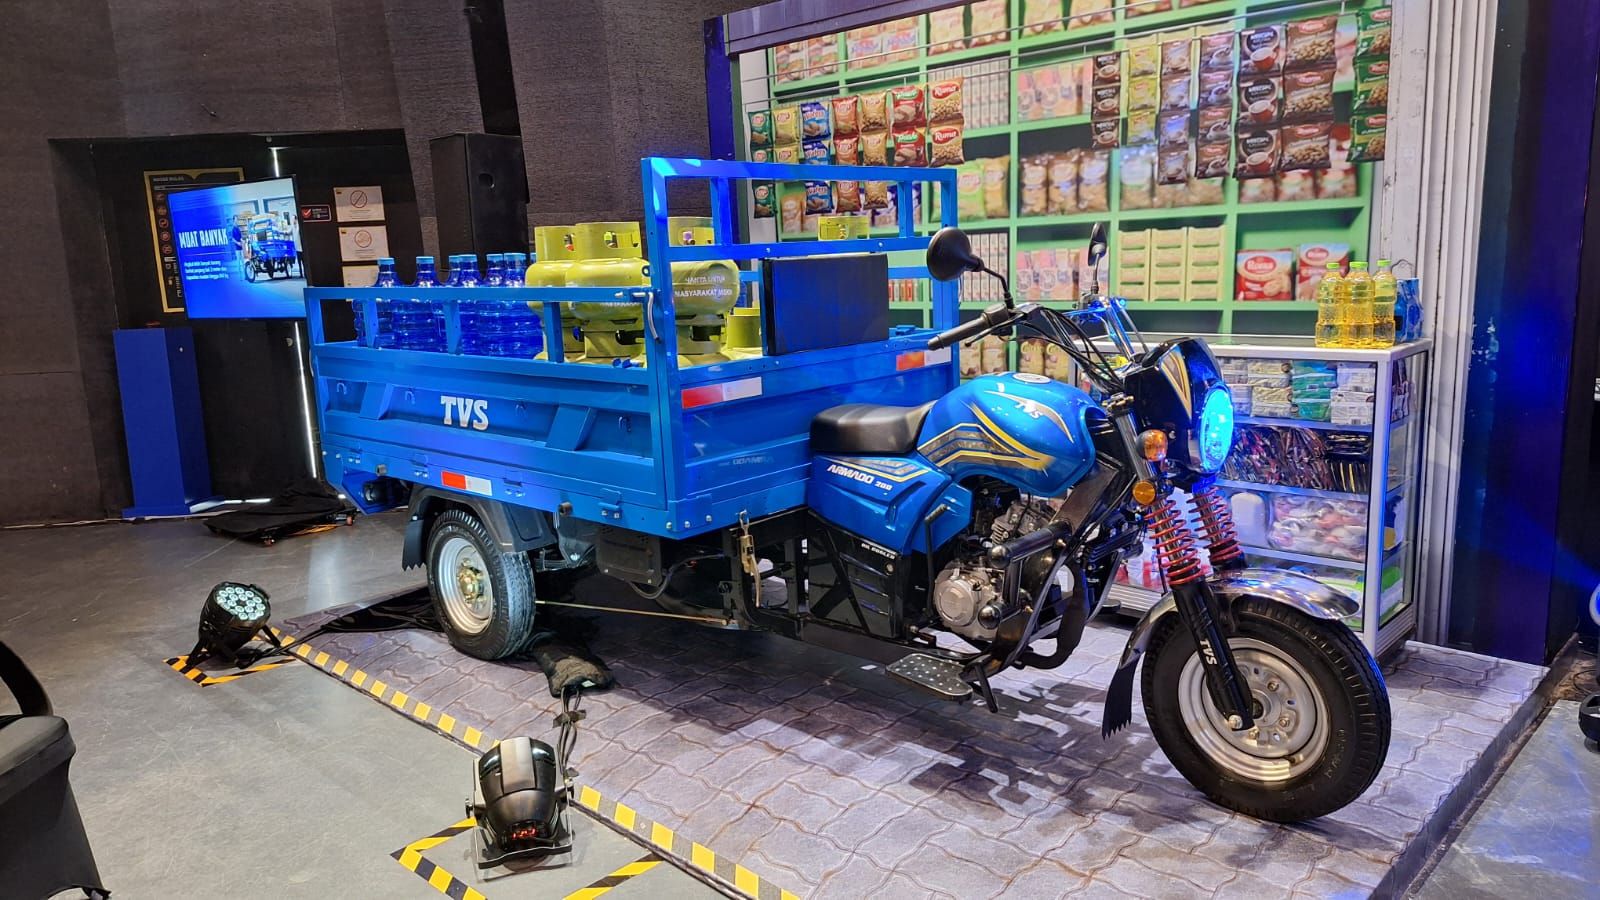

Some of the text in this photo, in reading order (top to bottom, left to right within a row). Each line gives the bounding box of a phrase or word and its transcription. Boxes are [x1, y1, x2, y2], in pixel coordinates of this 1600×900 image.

[440, 395, 490, 431] TVS
[827, 464, 875, 484] ARMADO
[1200, 638, 1218, 665] TVS
